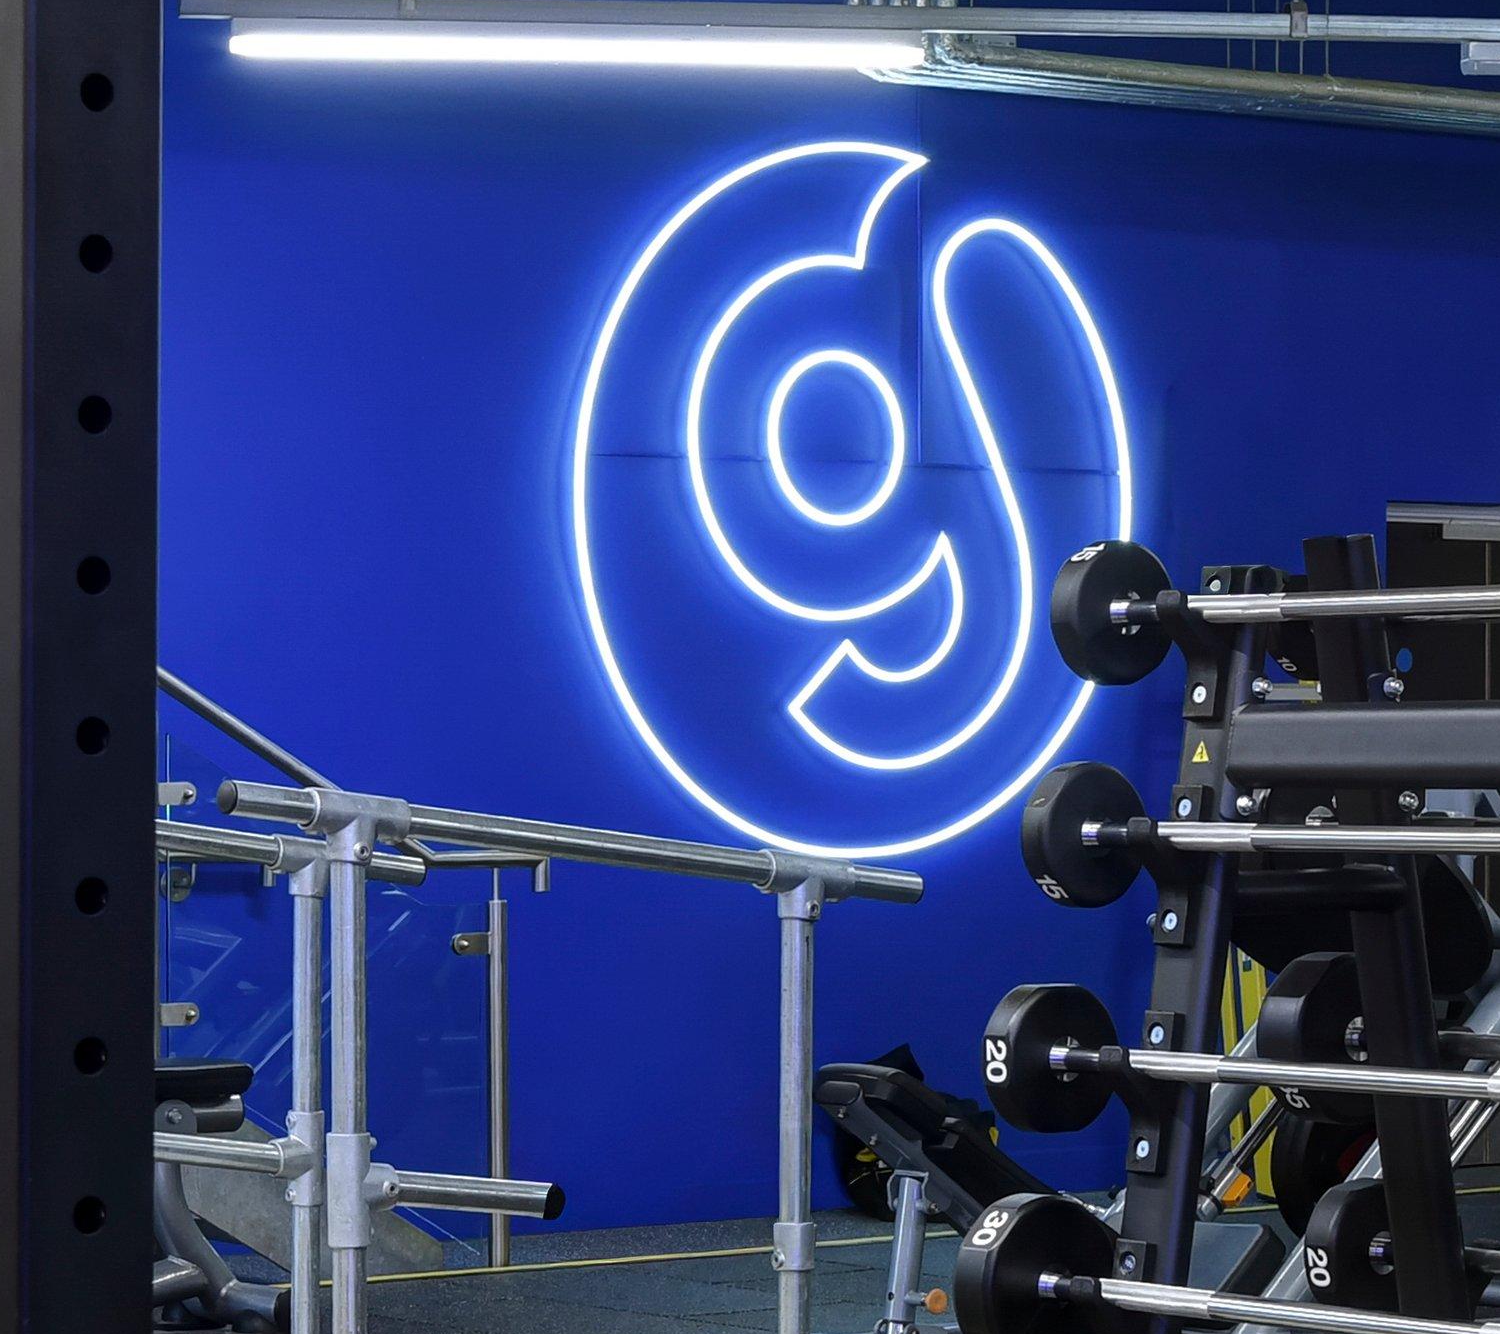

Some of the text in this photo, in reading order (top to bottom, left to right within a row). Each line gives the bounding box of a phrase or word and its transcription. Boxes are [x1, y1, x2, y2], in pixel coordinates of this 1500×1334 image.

[1035, 874, 1069, 899] 15
[984, 1038, 1008, 1084] 20
[971, 1210, 1009, 1248] 30
[1306, 1246, 1331, 1289] 20
